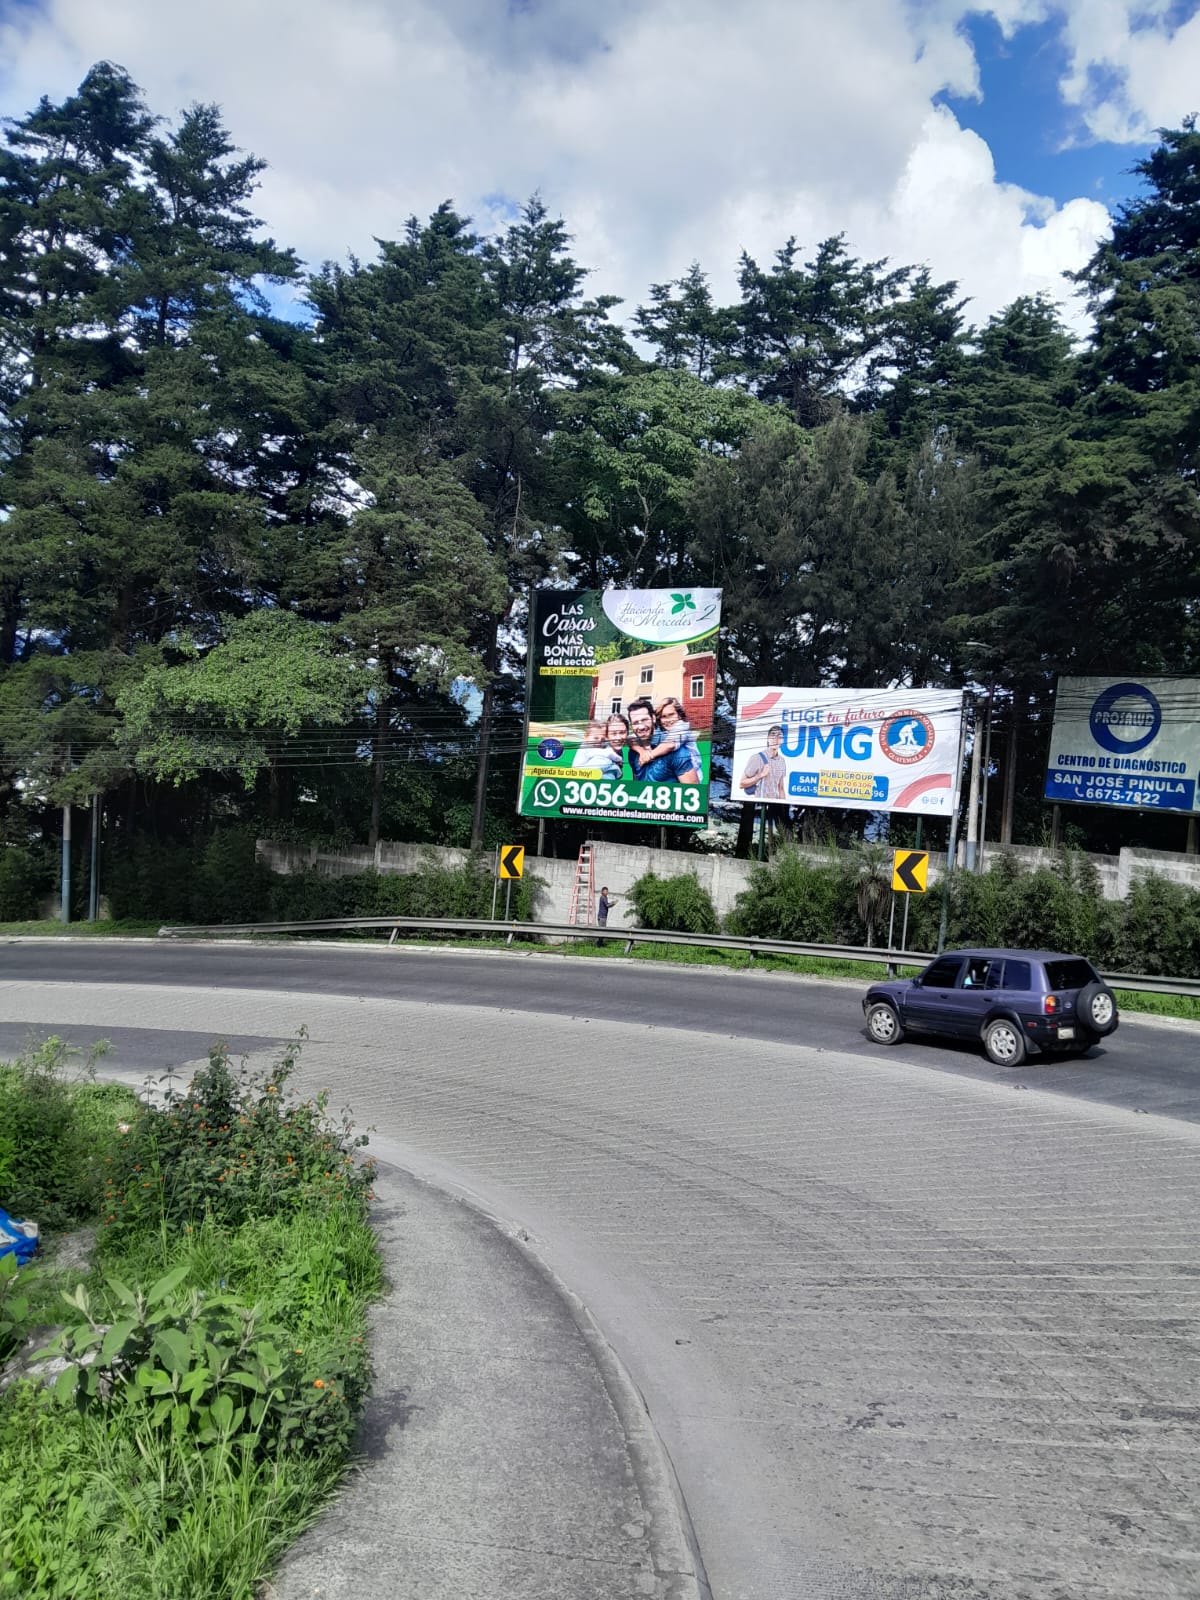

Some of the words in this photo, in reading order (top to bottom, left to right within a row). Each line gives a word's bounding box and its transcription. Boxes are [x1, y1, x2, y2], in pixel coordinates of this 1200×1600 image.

[562, 604, 584, 615] LAS
[620, 601, 664, 615] Hacienda
[695, 604, 717, 622] 2
[543, 614, 597, 637] Casas
[557, 631, 584, 645] MÁS
[544, 646, 595, 657] BONITAS
[547, 657, 562, 666] del
[565, 658, 597, 666] sector
[782, 709, 824, 723] ELIGE
[827, 712, 840, 723] tu
[844, 708, 886, 727] futuro
[780, 724, 873, 761] UMG
[1058, 754, 1096, 768] CENTRO
[1098, 757, 1111, 768] DE
[1113, 758, 1186, 774] DIAGNÓSTICO
[579, 770, 593, 778] hoy!
[799, 775, 817, 784] SAN
[820, 772, 873, 781] PUBLIGROUP
[819, 785, 829, 793] SE
[831, 786, 871, 795] ALQUILA
[1054, 773, 1082, 785] SAN
[1086, 775, 1124, 788] JOSÉ
[1129, 780, 1186, 793] PINULA
[564, 781, 700, 812] 3056-4813
[1086, 788, 1161, 804] 6675-7822
[562, 807, 704, 823] www.residencialeslasmercedes.com
